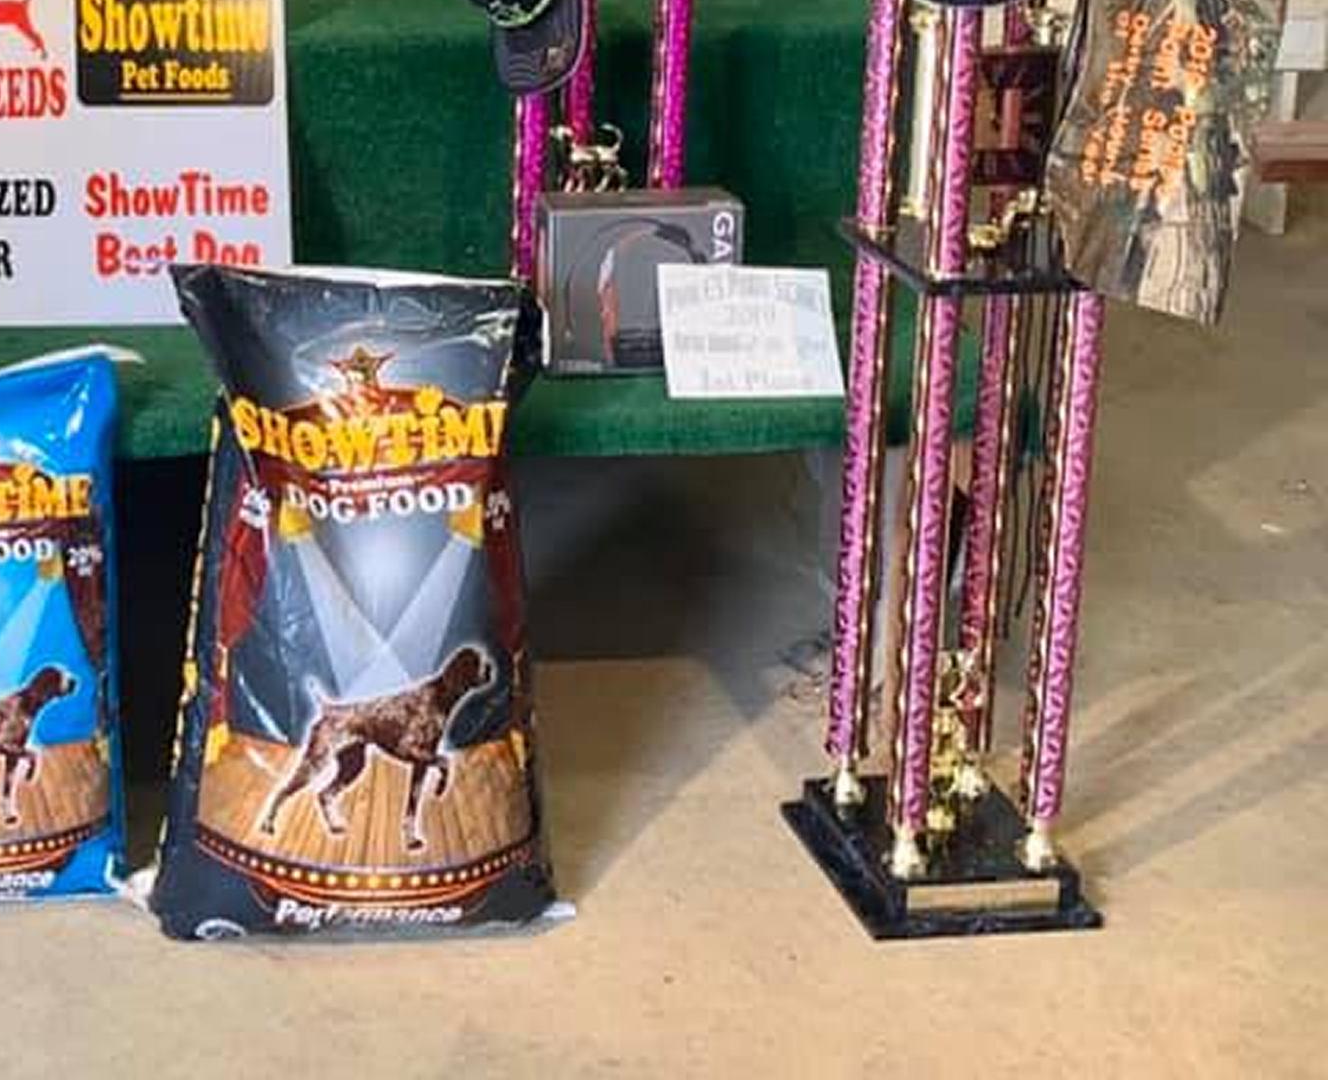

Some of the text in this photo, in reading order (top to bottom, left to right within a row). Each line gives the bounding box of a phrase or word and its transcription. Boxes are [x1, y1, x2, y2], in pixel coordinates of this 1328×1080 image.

[121, 61, 229, 91] Pet Foods
[85, 170, 269, 218] ShowTime
[288, 482, 356, 524] DOG
[366, 480, 473, 519] FOOD
